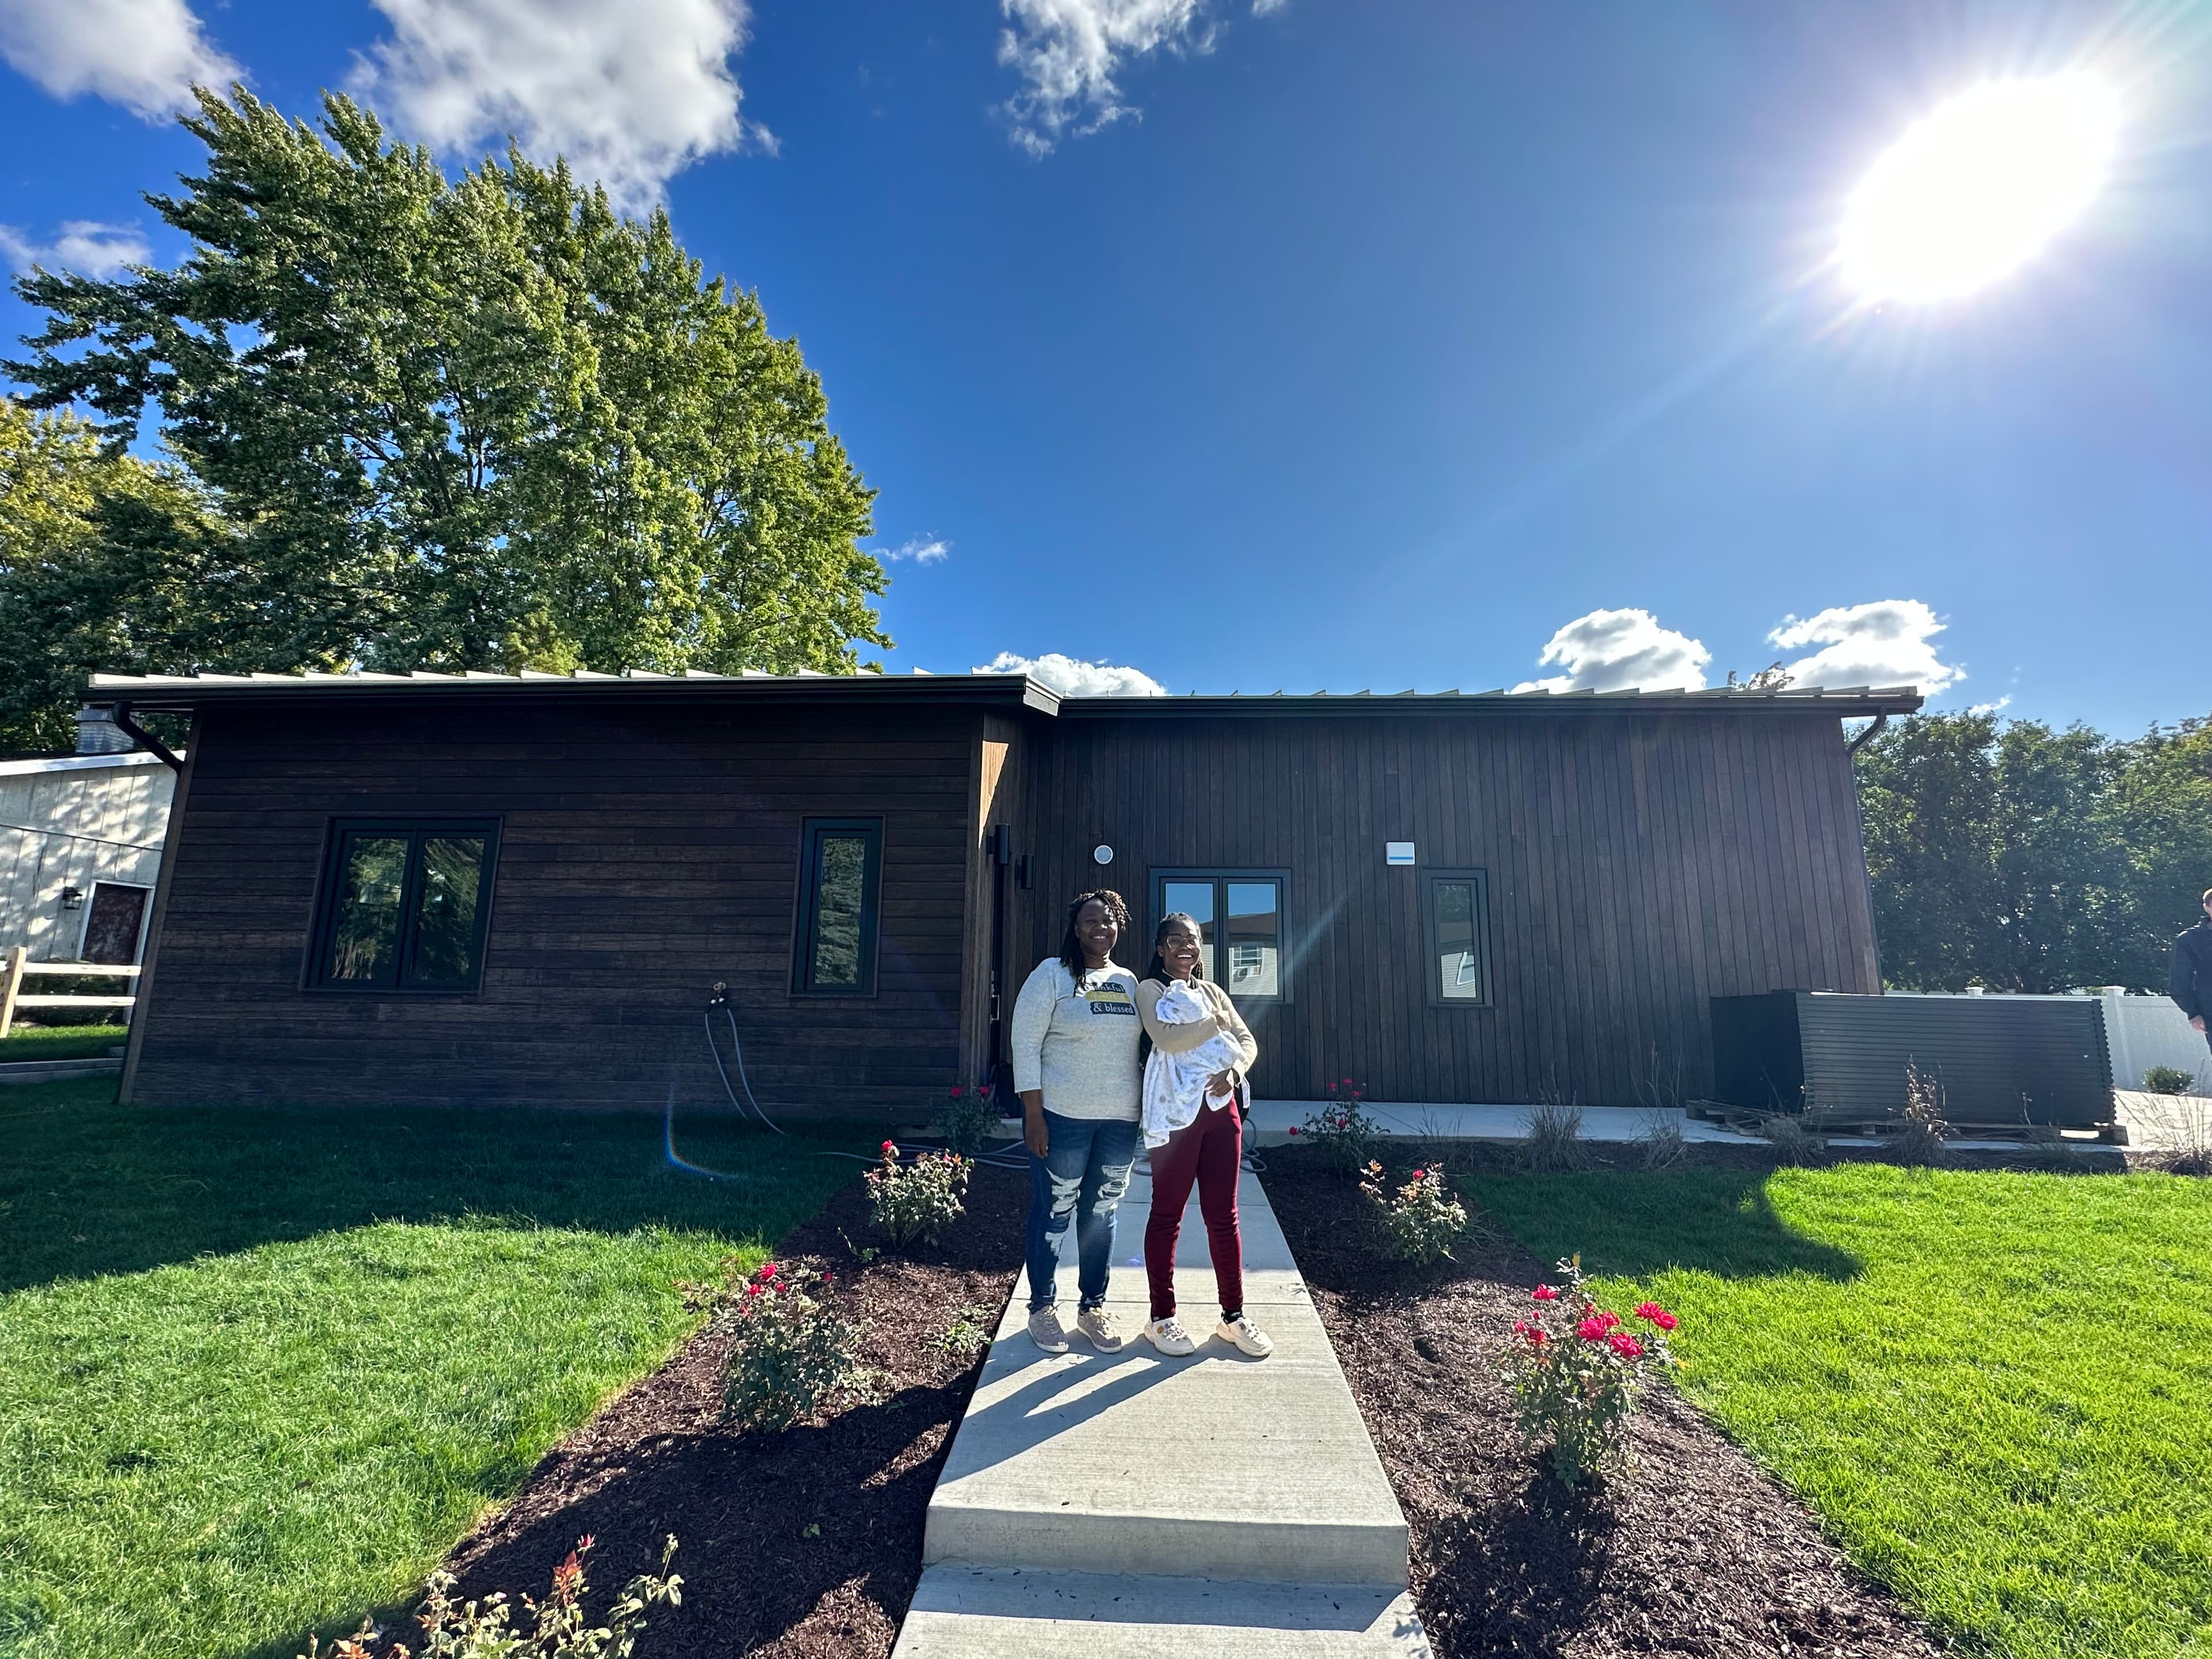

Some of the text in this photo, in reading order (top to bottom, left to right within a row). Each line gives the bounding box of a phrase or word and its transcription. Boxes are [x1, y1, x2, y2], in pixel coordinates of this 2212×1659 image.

[1087, 983, 1124, 992] nkful
[1093, 1003, 1134, 1013] & blessed
